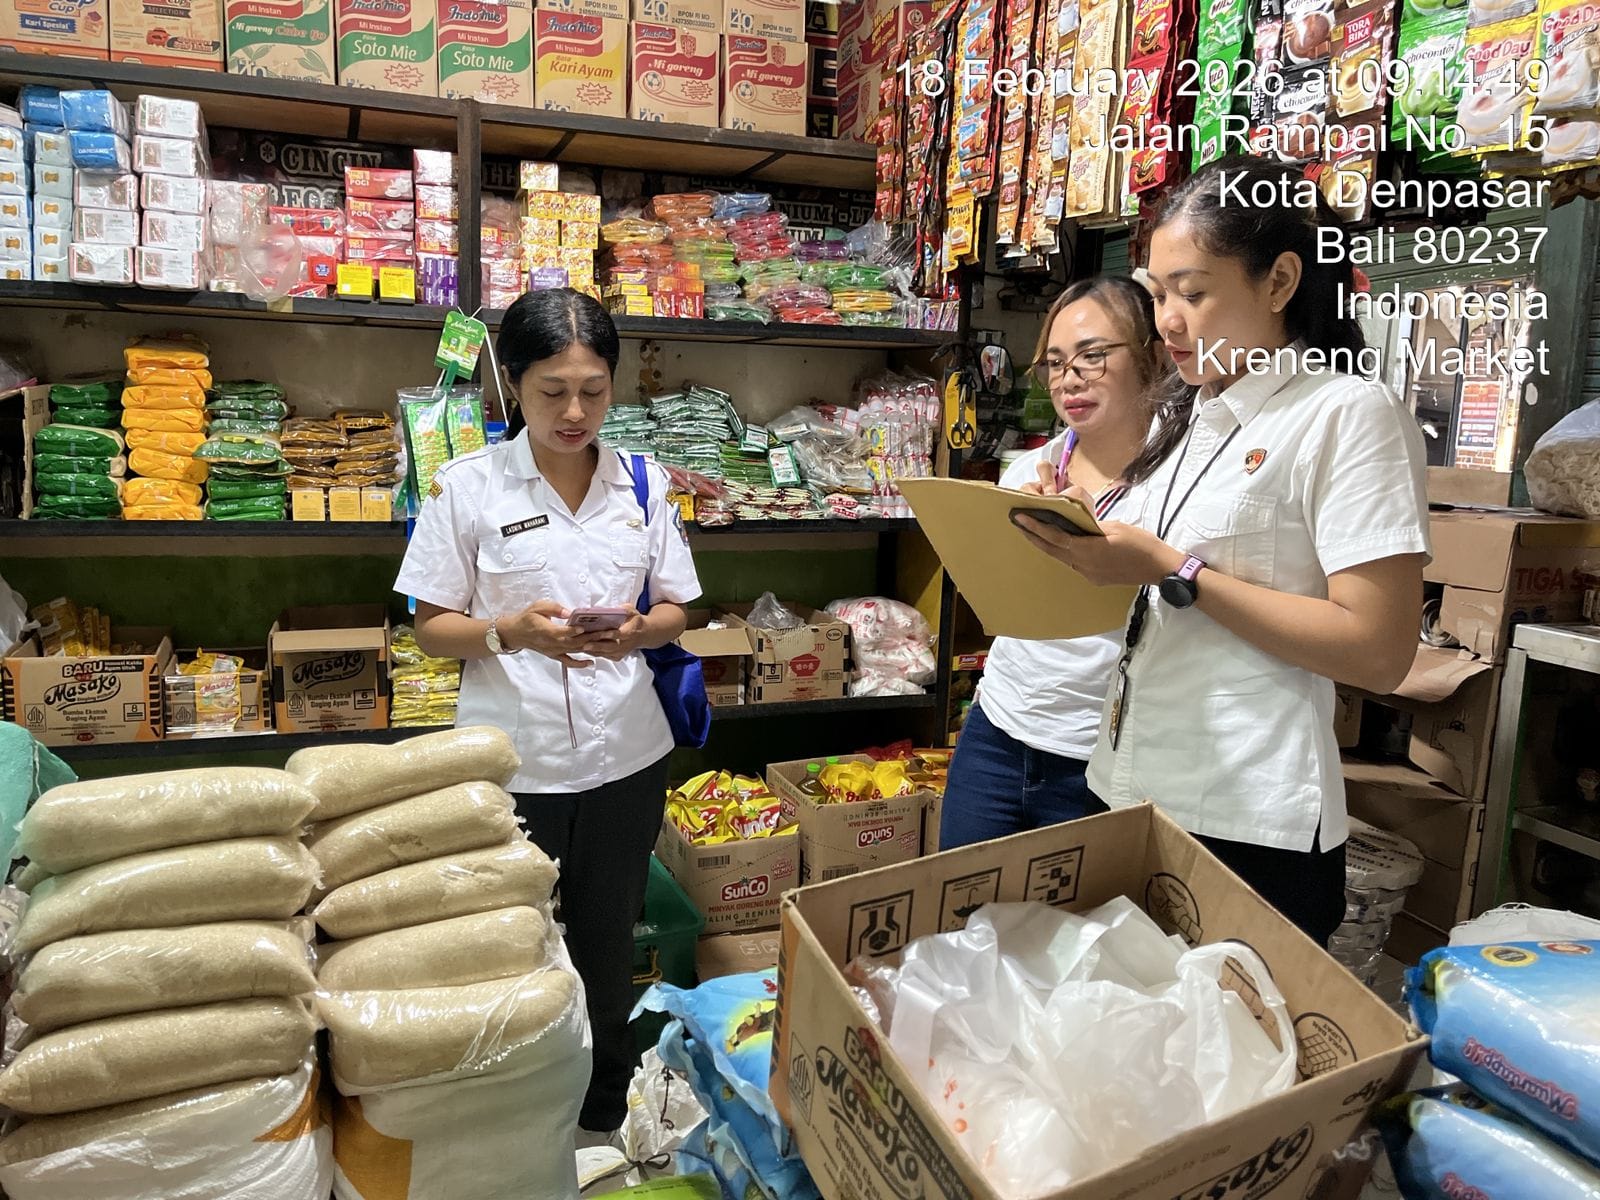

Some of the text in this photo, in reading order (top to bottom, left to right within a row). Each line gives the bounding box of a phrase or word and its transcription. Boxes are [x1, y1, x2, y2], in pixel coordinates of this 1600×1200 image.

[48, 3, 74, 14] Cup
[149, 7, 186, 16] SELECTION
[247, 5, 282, 15] Mi Instan
[643, 0, 669, 17] 40
[1211, 0, 1234, 15] MILO
[25, 18, 42, 27] Kari
[43, 20, 70, 30] Spesial
[730, 8, 754, 29] 40
[1347, 18, 1371, 33] TORA
[1543, 3, 1600, 33] Good Da
[245, 24, 273, 35] goreng
[358, 21, 392, 32] Mi Instan
[467, 34, 489, 43] Instan
[1348, 30, 1370, 43] BIKA
[353, 39, 417, 61] Soto Mie
[565, 44, 585, 53] Instan
[1464, 39, 1531, 63] Good Day
[453, 50, 514, 71] Soto Mie
[549, 60, 613, 80] Kari Ayam
[666, 62, 703, 76] goreng
[758, 72, 793, 85] goreng
[350, 178, 370, 187] POCI
[1515, 567, 1564, 592] TIGA
[63, 660, 103, 678] BARU
[293, 650, 363, 684] Masako
[44, 673, 119, 706] Masako
[859, 826, 893, 846] SunCo
[724, 879, 766, 900] SunCo
[708, 904, 735, 913] MINYAK
[736, 901, 764, 910] GORENG
[705, 913, 740, 923] ALING
[845, 1026, 907, 1121] BARU
[816, 1046, 921, 1183] Masako
